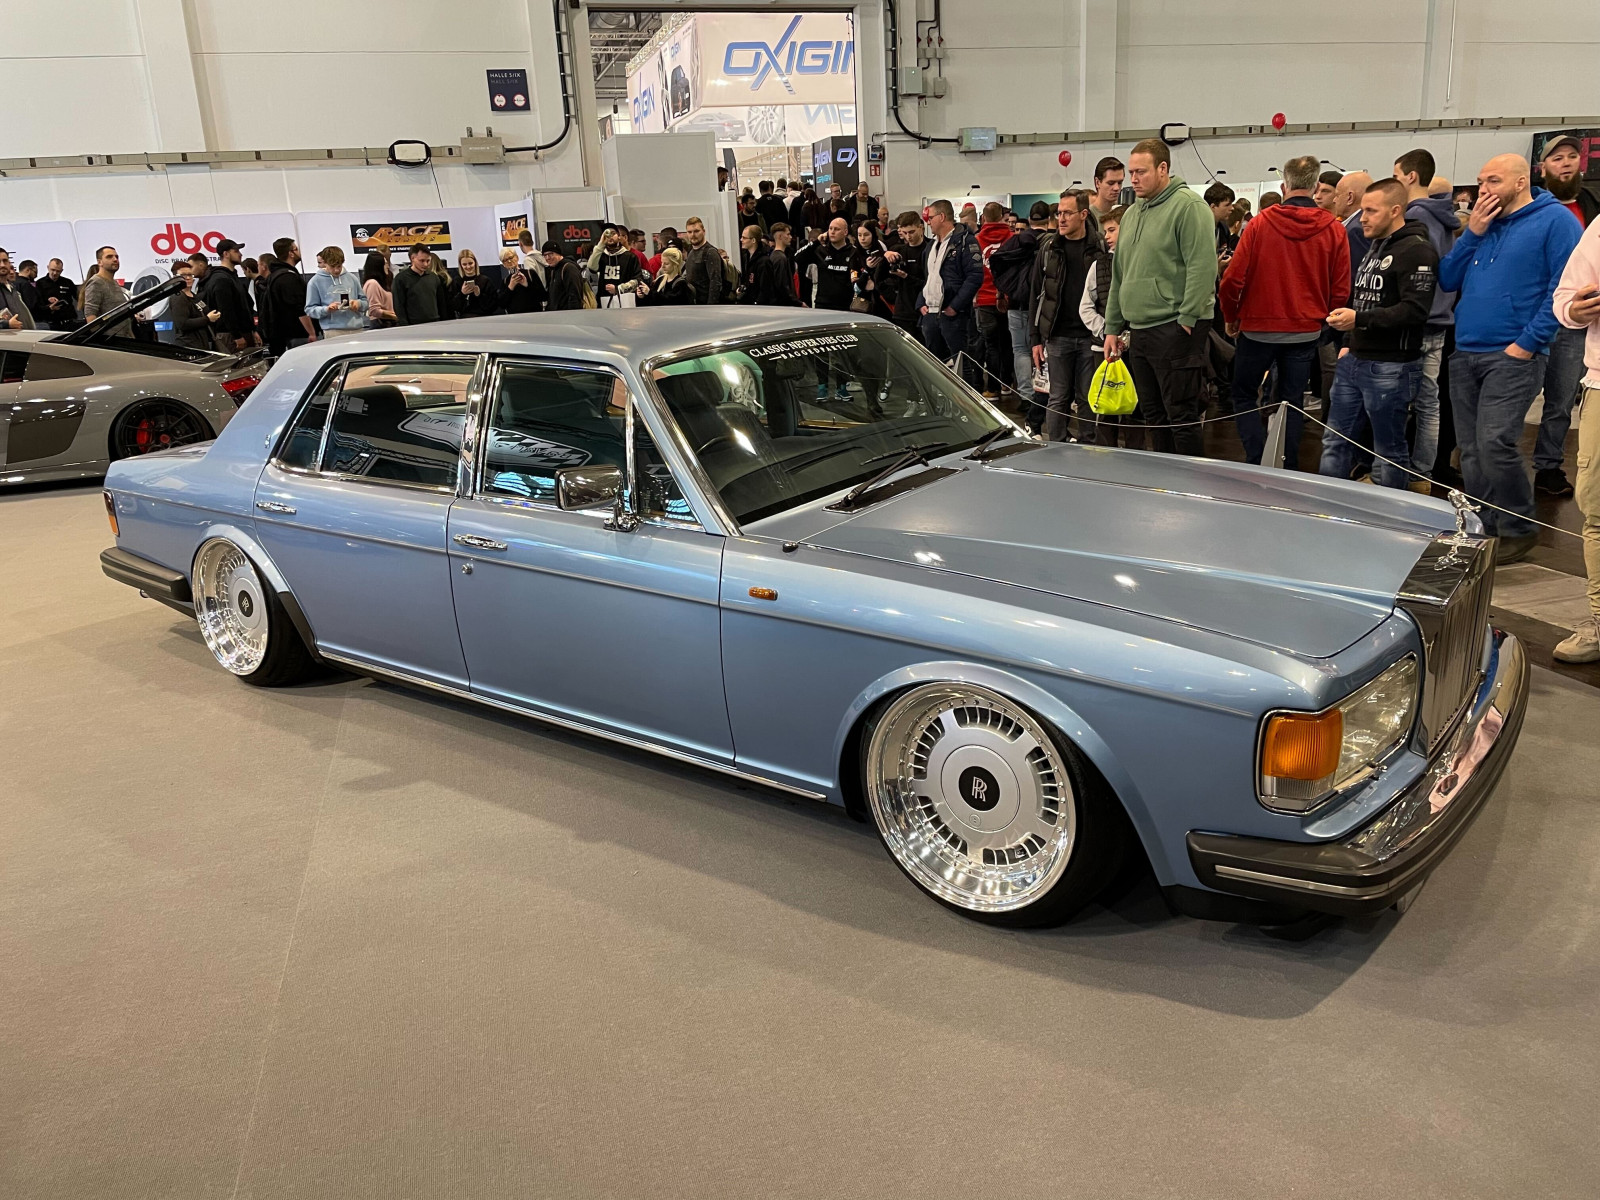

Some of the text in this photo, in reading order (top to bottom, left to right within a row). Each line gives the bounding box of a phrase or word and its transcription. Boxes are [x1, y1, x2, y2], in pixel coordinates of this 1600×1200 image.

[372, 224, 443, 237] RACE
[563, 225, 591, 239] dba
[749, 334, 859, 358] CLASSIC NEVER DIES CLUB
[971, 776, 988, 802] RR
